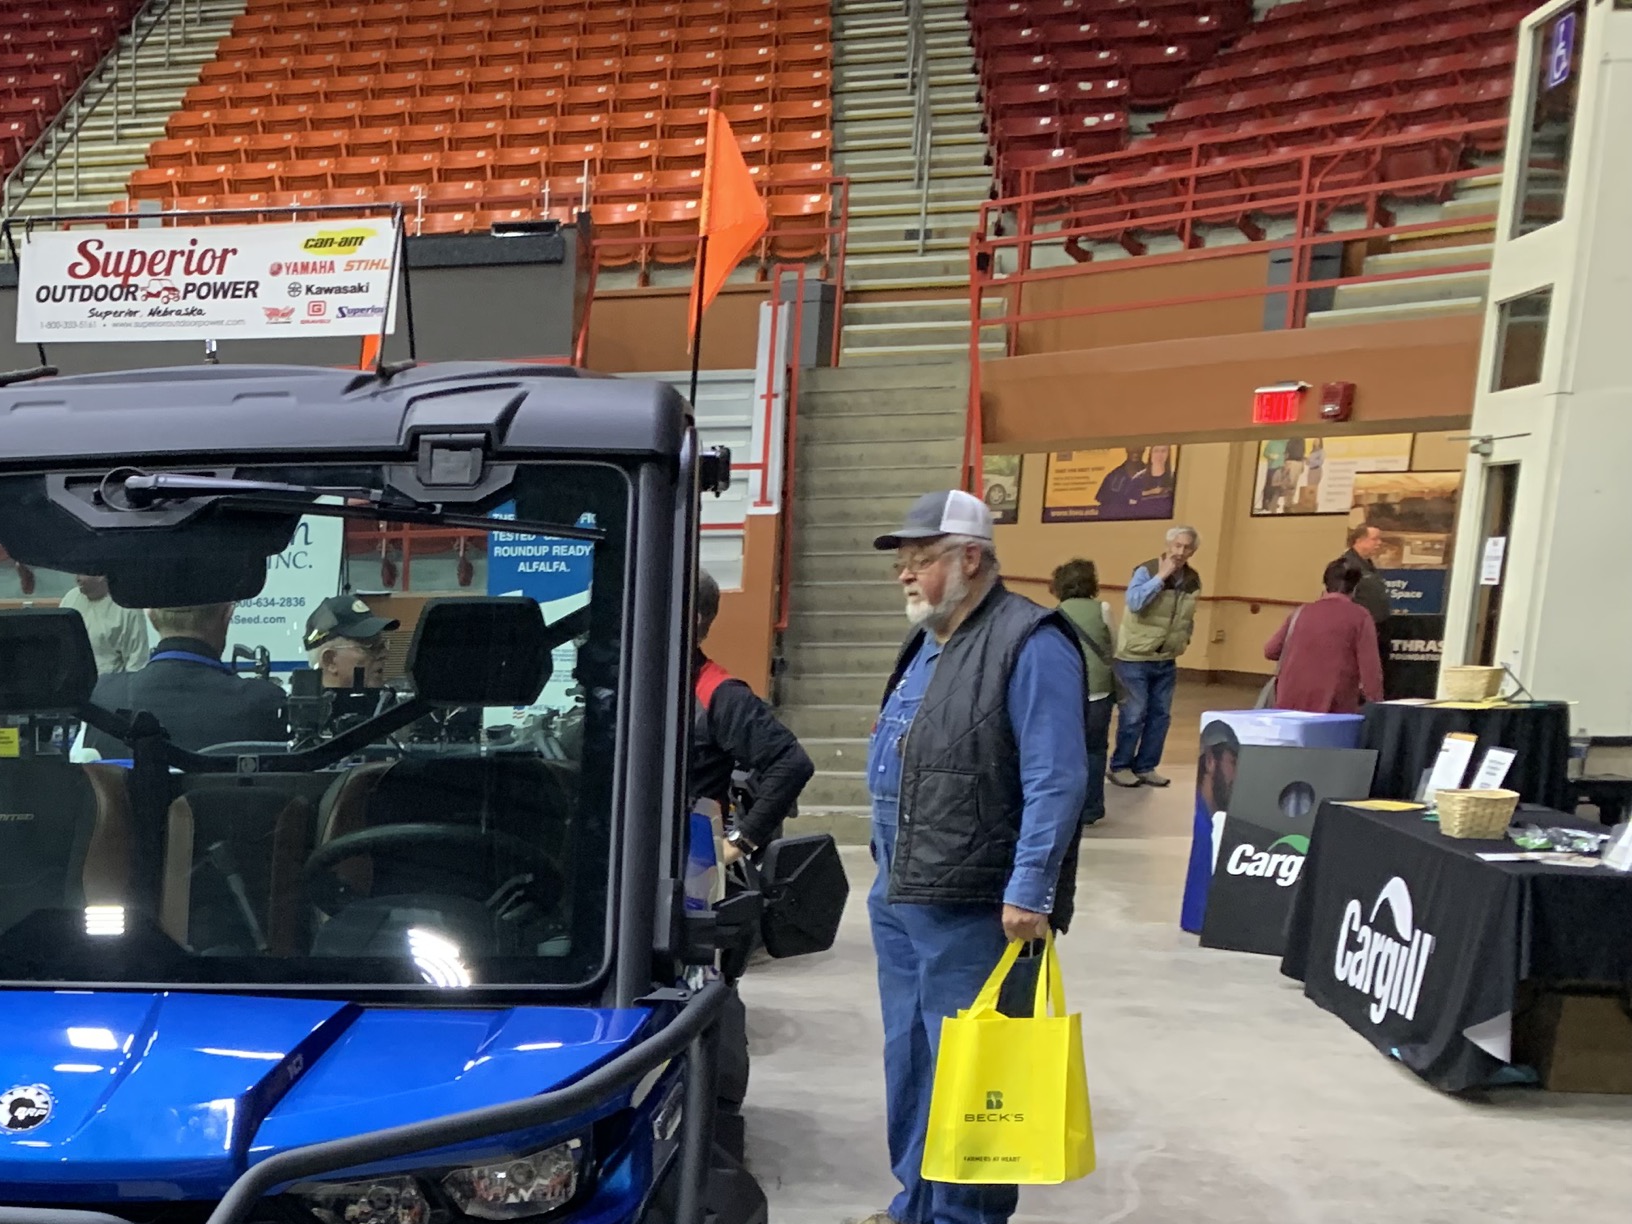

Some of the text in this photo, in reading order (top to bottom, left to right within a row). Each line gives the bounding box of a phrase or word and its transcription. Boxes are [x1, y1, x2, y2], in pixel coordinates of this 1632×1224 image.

[303, 236, 365, 249] can-am
[67, 238, 238, 288] Superior
[285, 260, 336, 275] YAMAHA
[343, 259, 390, 271] STIHL
[35, 280, 260, 303] OUTDOOR POWER
[305, 282, 370, 295] Kawasaki
[147, 306, 206, 317] Nebraska
[1257, 393, 1296, 420] EXIT
[494, 545, 592, 557] ROUNDUP READY
[517, 562, 570, 573] ALFALFA.
[1390, 589, 1424, 600] Space
[1334, 899, 1432, 1025] Cargill
[964, 1113, 1025, 1122] BECK'S
